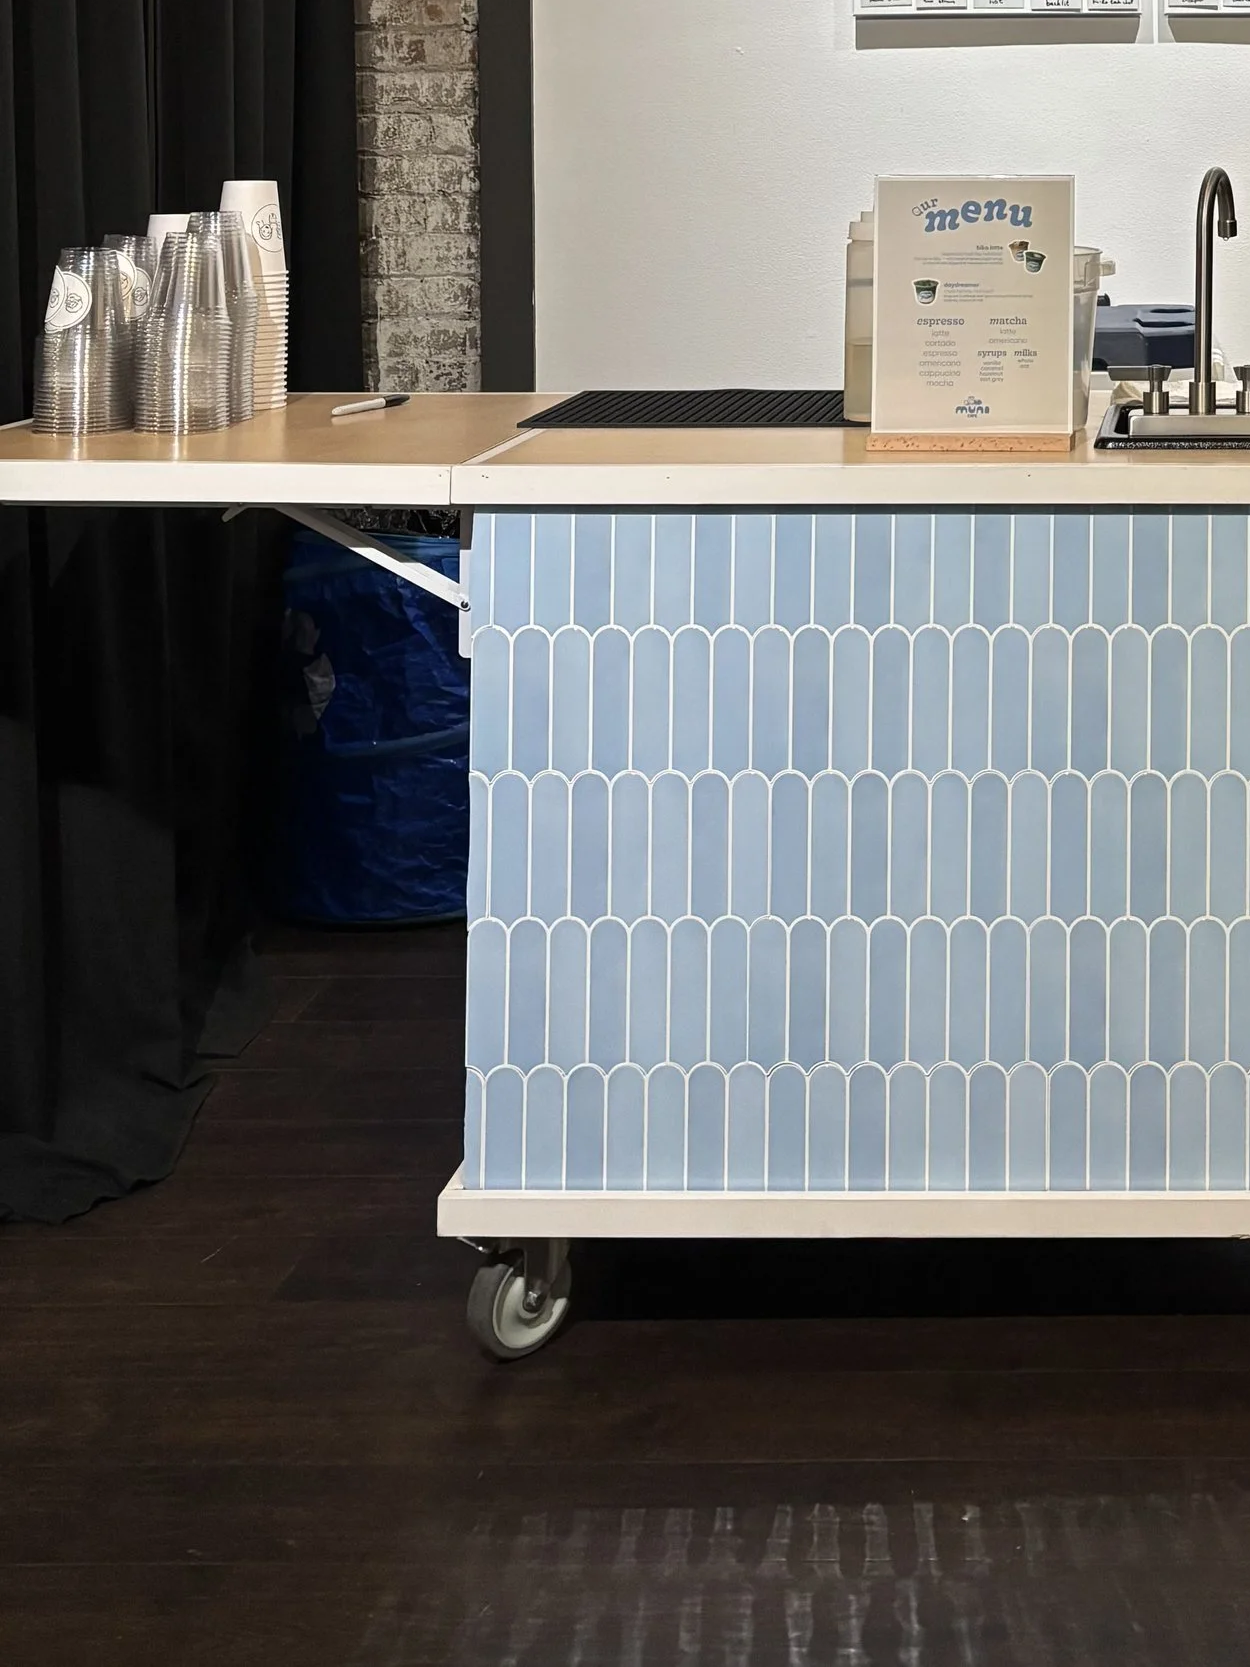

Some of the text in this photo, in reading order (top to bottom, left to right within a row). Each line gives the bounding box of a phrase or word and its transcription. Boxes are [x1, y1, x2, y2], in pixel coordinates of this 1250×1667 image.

[911, 198, 938, 217] our
[924, 198, 1033, 233] menu
[917, 317, 965, 328] espresso
[989, 316, 1028, 325] matcha
[977, 349, 1008, 358] syrups
[1013, 348, 1038, 357] milks
